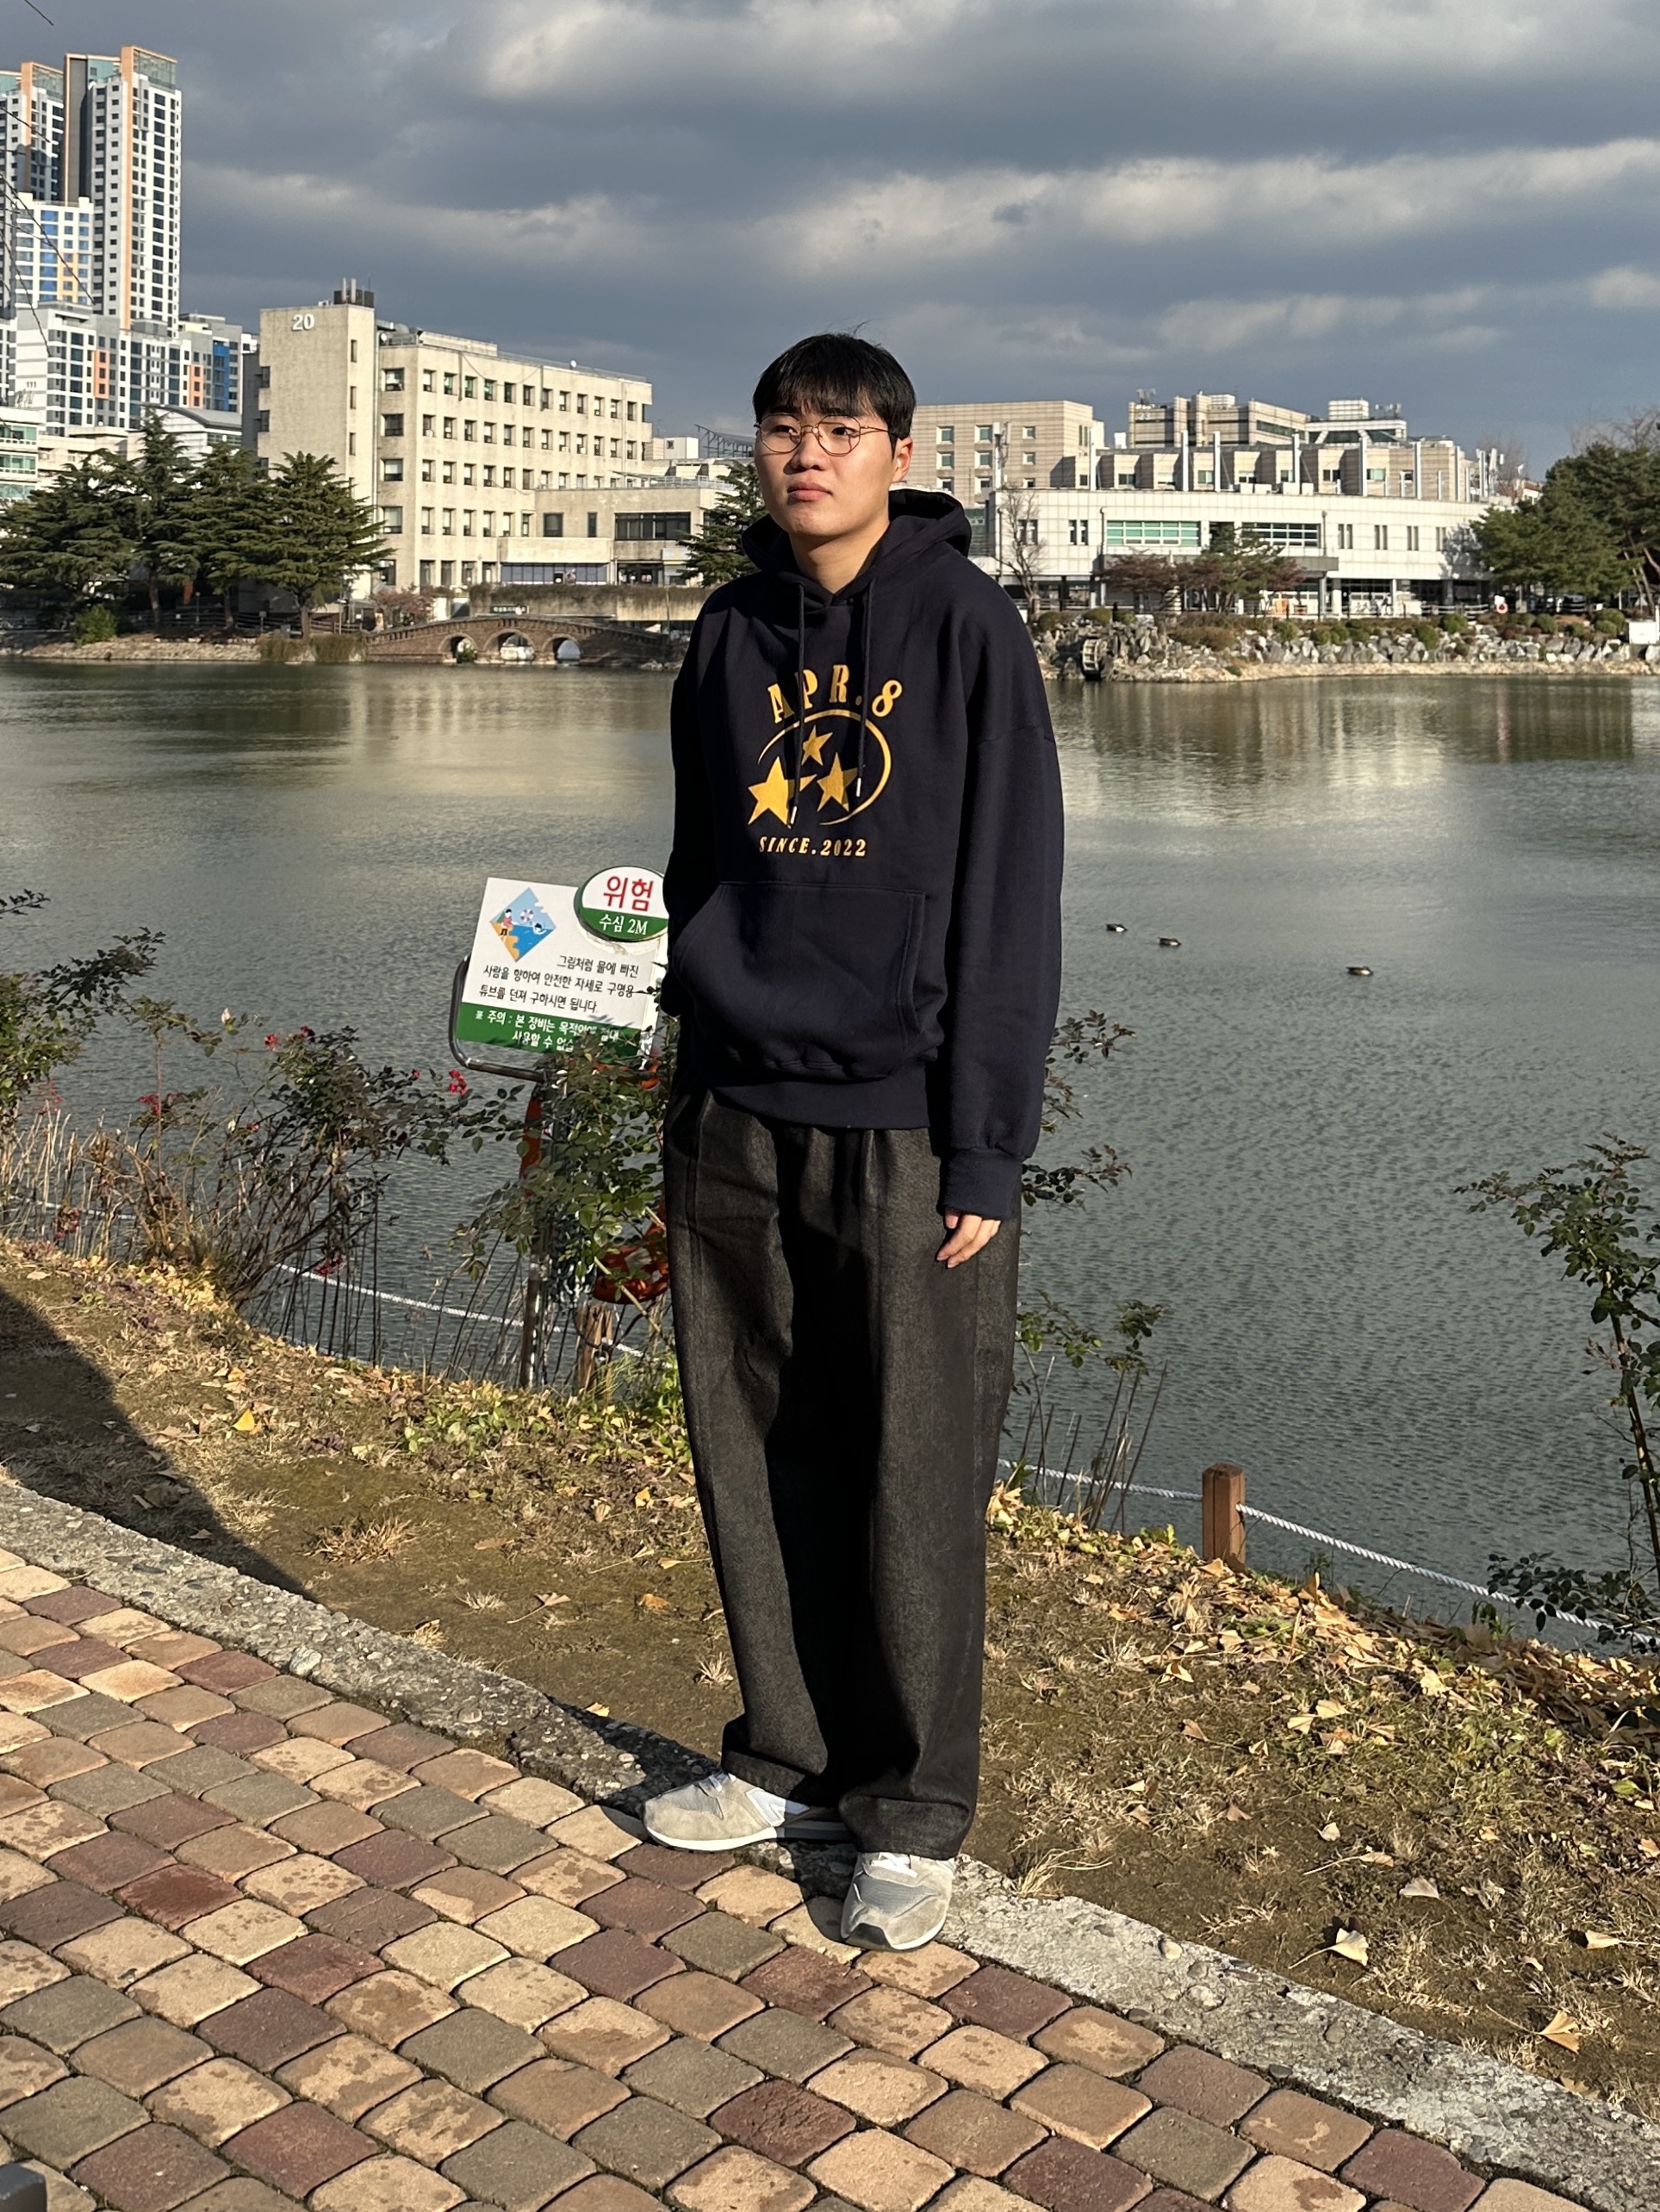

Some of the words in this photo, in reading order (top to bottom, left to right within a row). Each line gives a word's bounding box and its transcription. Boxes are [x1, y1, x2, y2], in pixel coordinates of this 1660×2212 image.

[293, 314, 315, 330] 20
[603, 876, 654, 911] 위험
[599, 914, 625, 932] 수심
[627, 918, 649, 935] 2M
[557, 955, 594, 972] 그림처럼
[597, 960, 616, 975] 물에
[620, 964, 638, 979] 빠진
[483, 964, 509, 979] 사람을
[513, 969, 541, 985] 향하여
[544, 972, 572, 989] 안전한
[575, 978, 603, 993] 자세로
[607, 982, 634, 998] 구명용
[479, 985, 506, 1000] 튜브를
[510, 989, 526, 1003] 던져
[530, 992, 567, 1009] 구하시면
[488, 1010, 507, 1025] 주의
[514, 1014, 525, 1028] 본
[528, 1016, 556, 1033] 장비는
[512, 1030, 541, 1047] 사용할
[543, 1035, 553, 1049] 수
